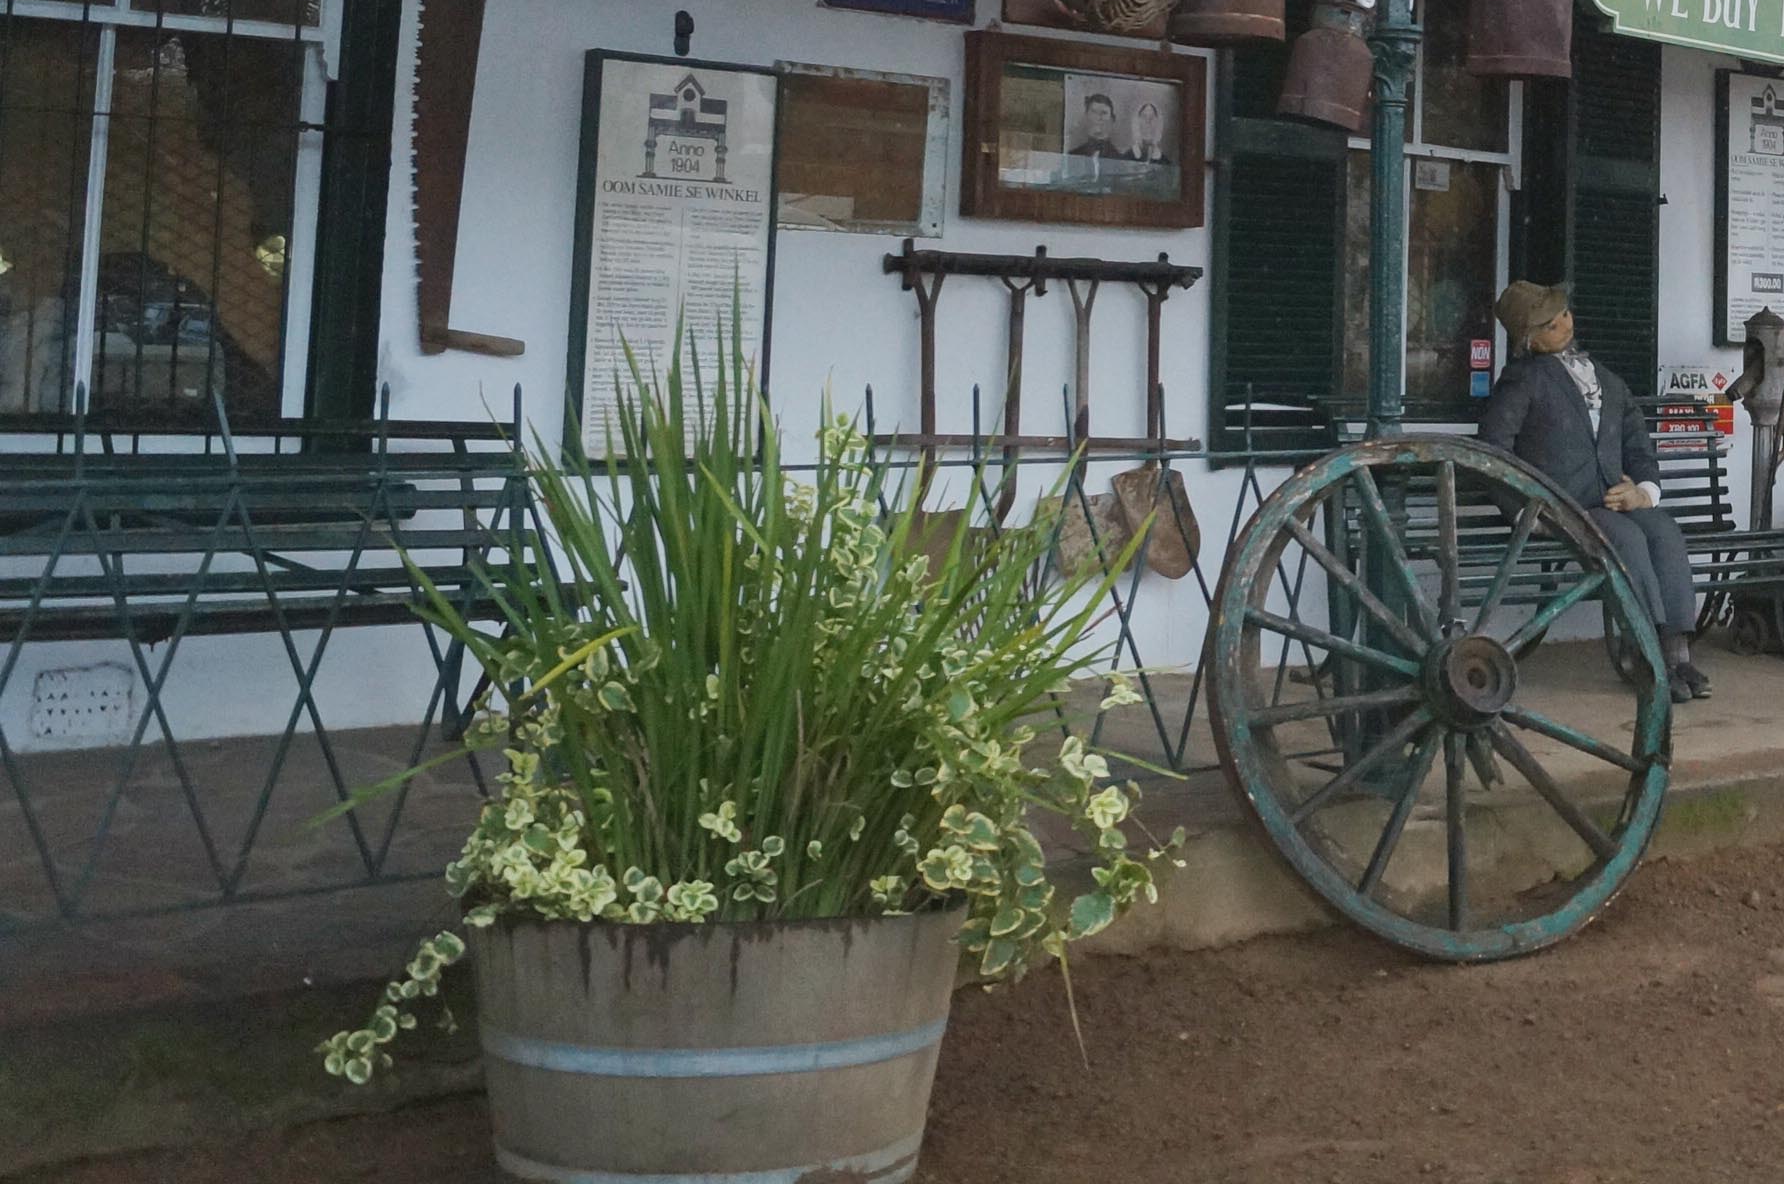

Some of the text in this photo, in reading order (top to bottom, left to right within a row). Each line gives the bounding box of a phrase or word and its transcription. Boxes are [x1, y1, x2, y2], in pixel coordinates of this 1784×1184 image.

[668, 141, 705, 157] Anno
[671, 157, 701, 173] 1904
[602, 180, 762, 203] OOM SAMIE SE WINKEL
[1670, 372, 1708, 390] AGFA
